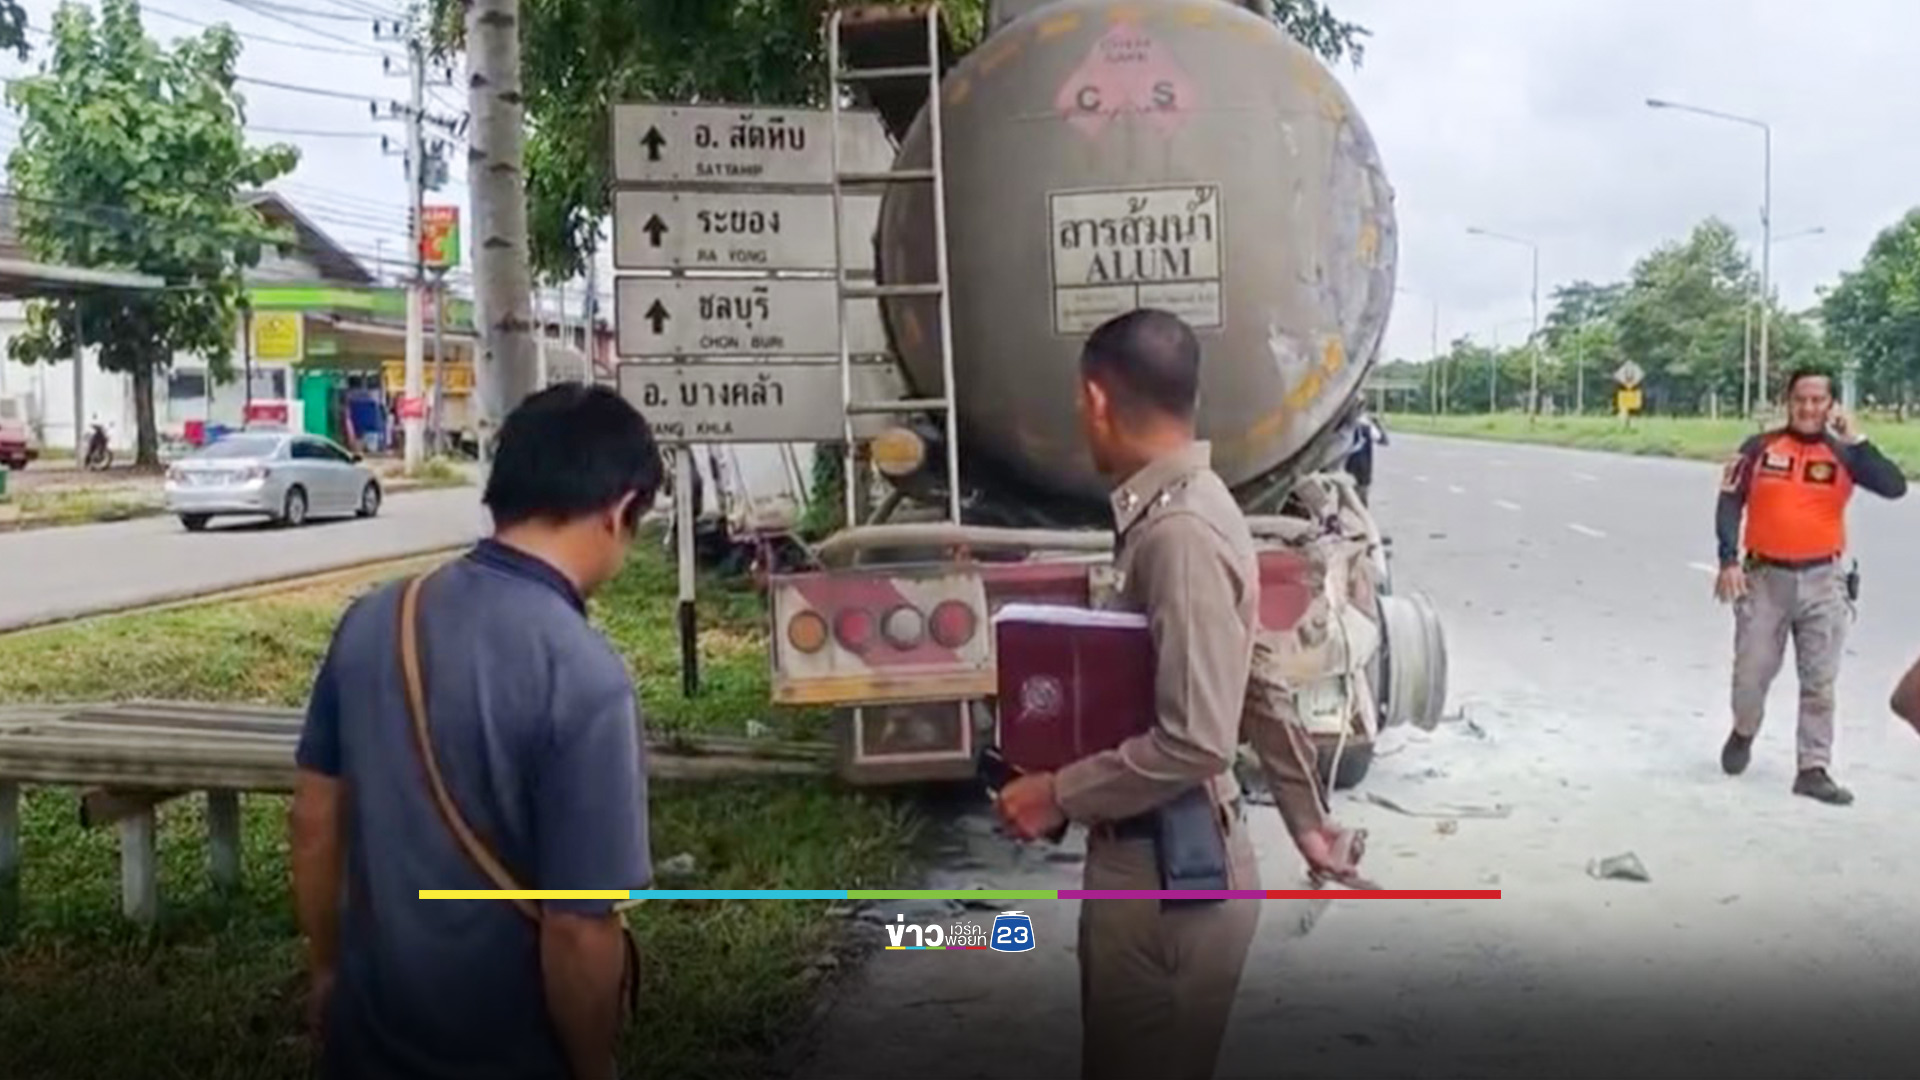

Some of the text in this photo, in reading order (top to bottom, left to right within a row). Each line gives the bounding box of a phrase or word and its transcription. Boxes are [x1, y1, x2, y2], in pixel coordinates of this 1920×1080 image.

[1077, 81, 1176, 111] C S
[695, 124, 719, 149] อ.
[697, 210, 780, 234] ระยอง
[1060, 186, 1212, 249] สารส้มน้ำ
[728, 249, 767, 263] YONG
[1087, 248, 1191, 283] ALUM
[699, 286, 769, 330] ชลบุรี
[699, 336, 784, 349] CHON BURI
[644, 373, 783, 407] อ. บางคล้า
[697, 421, 734, 435] KHLA
